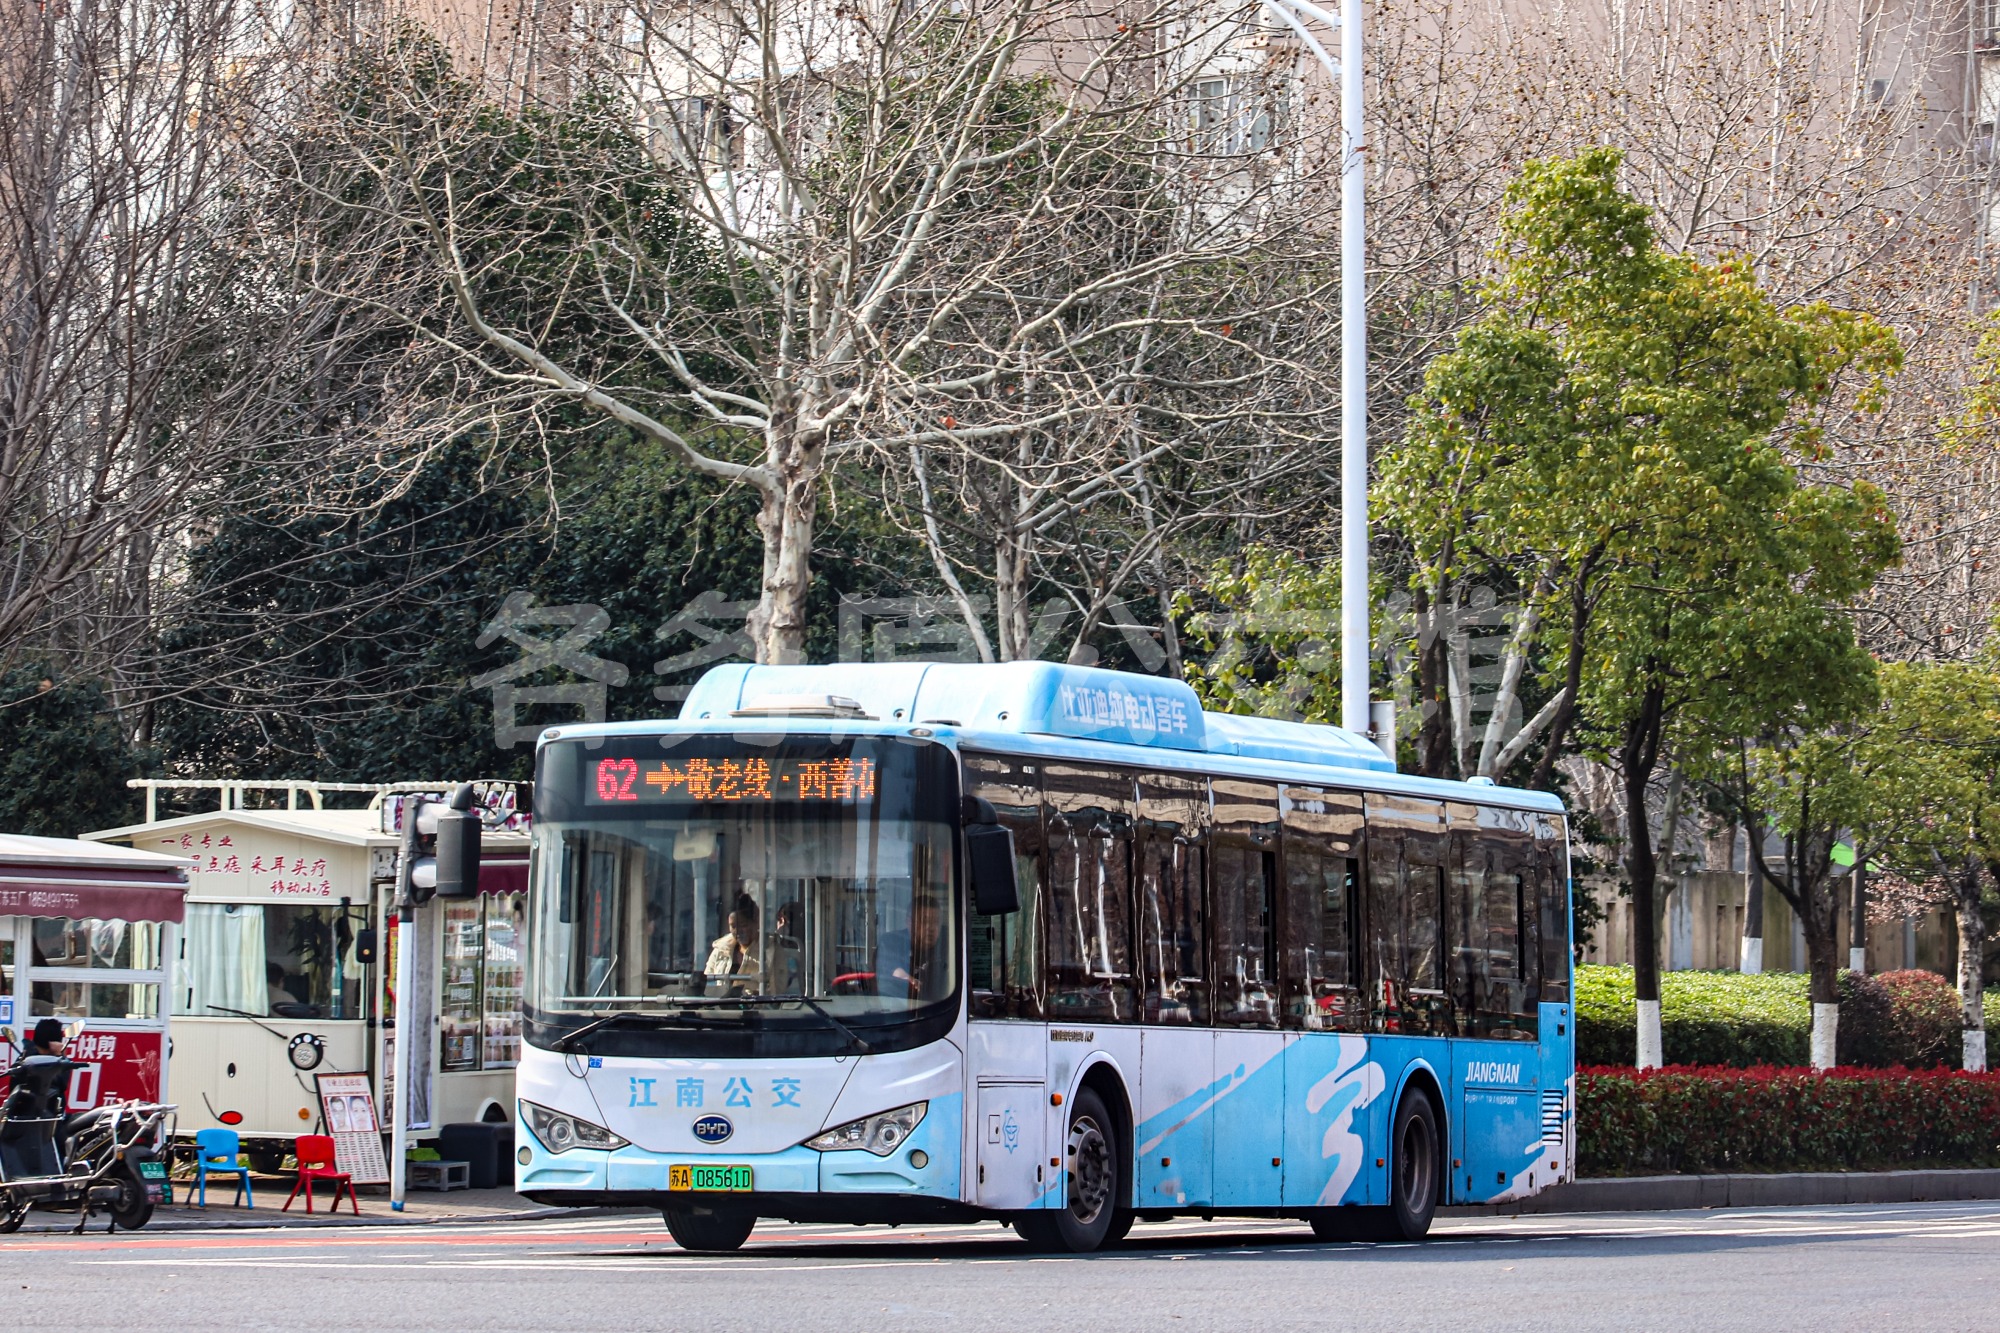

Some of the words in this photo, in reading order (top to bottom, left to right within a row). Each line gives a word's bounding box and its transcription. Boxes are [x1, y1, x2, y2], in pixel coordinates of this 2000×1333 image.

[1060, 685, 1188, 734] 比亚迪纯电动客车
[597, 757, 638, 800] 62
[161, 833, 233, 849] 一家专业
[270, 880, 331, 896] 移动小店
[1465, 1061, 1520, 1084] JIANGNAN
[628, 1076, 801, 1109] 江南公交
[696, 1122, 728, 1135] BYD
